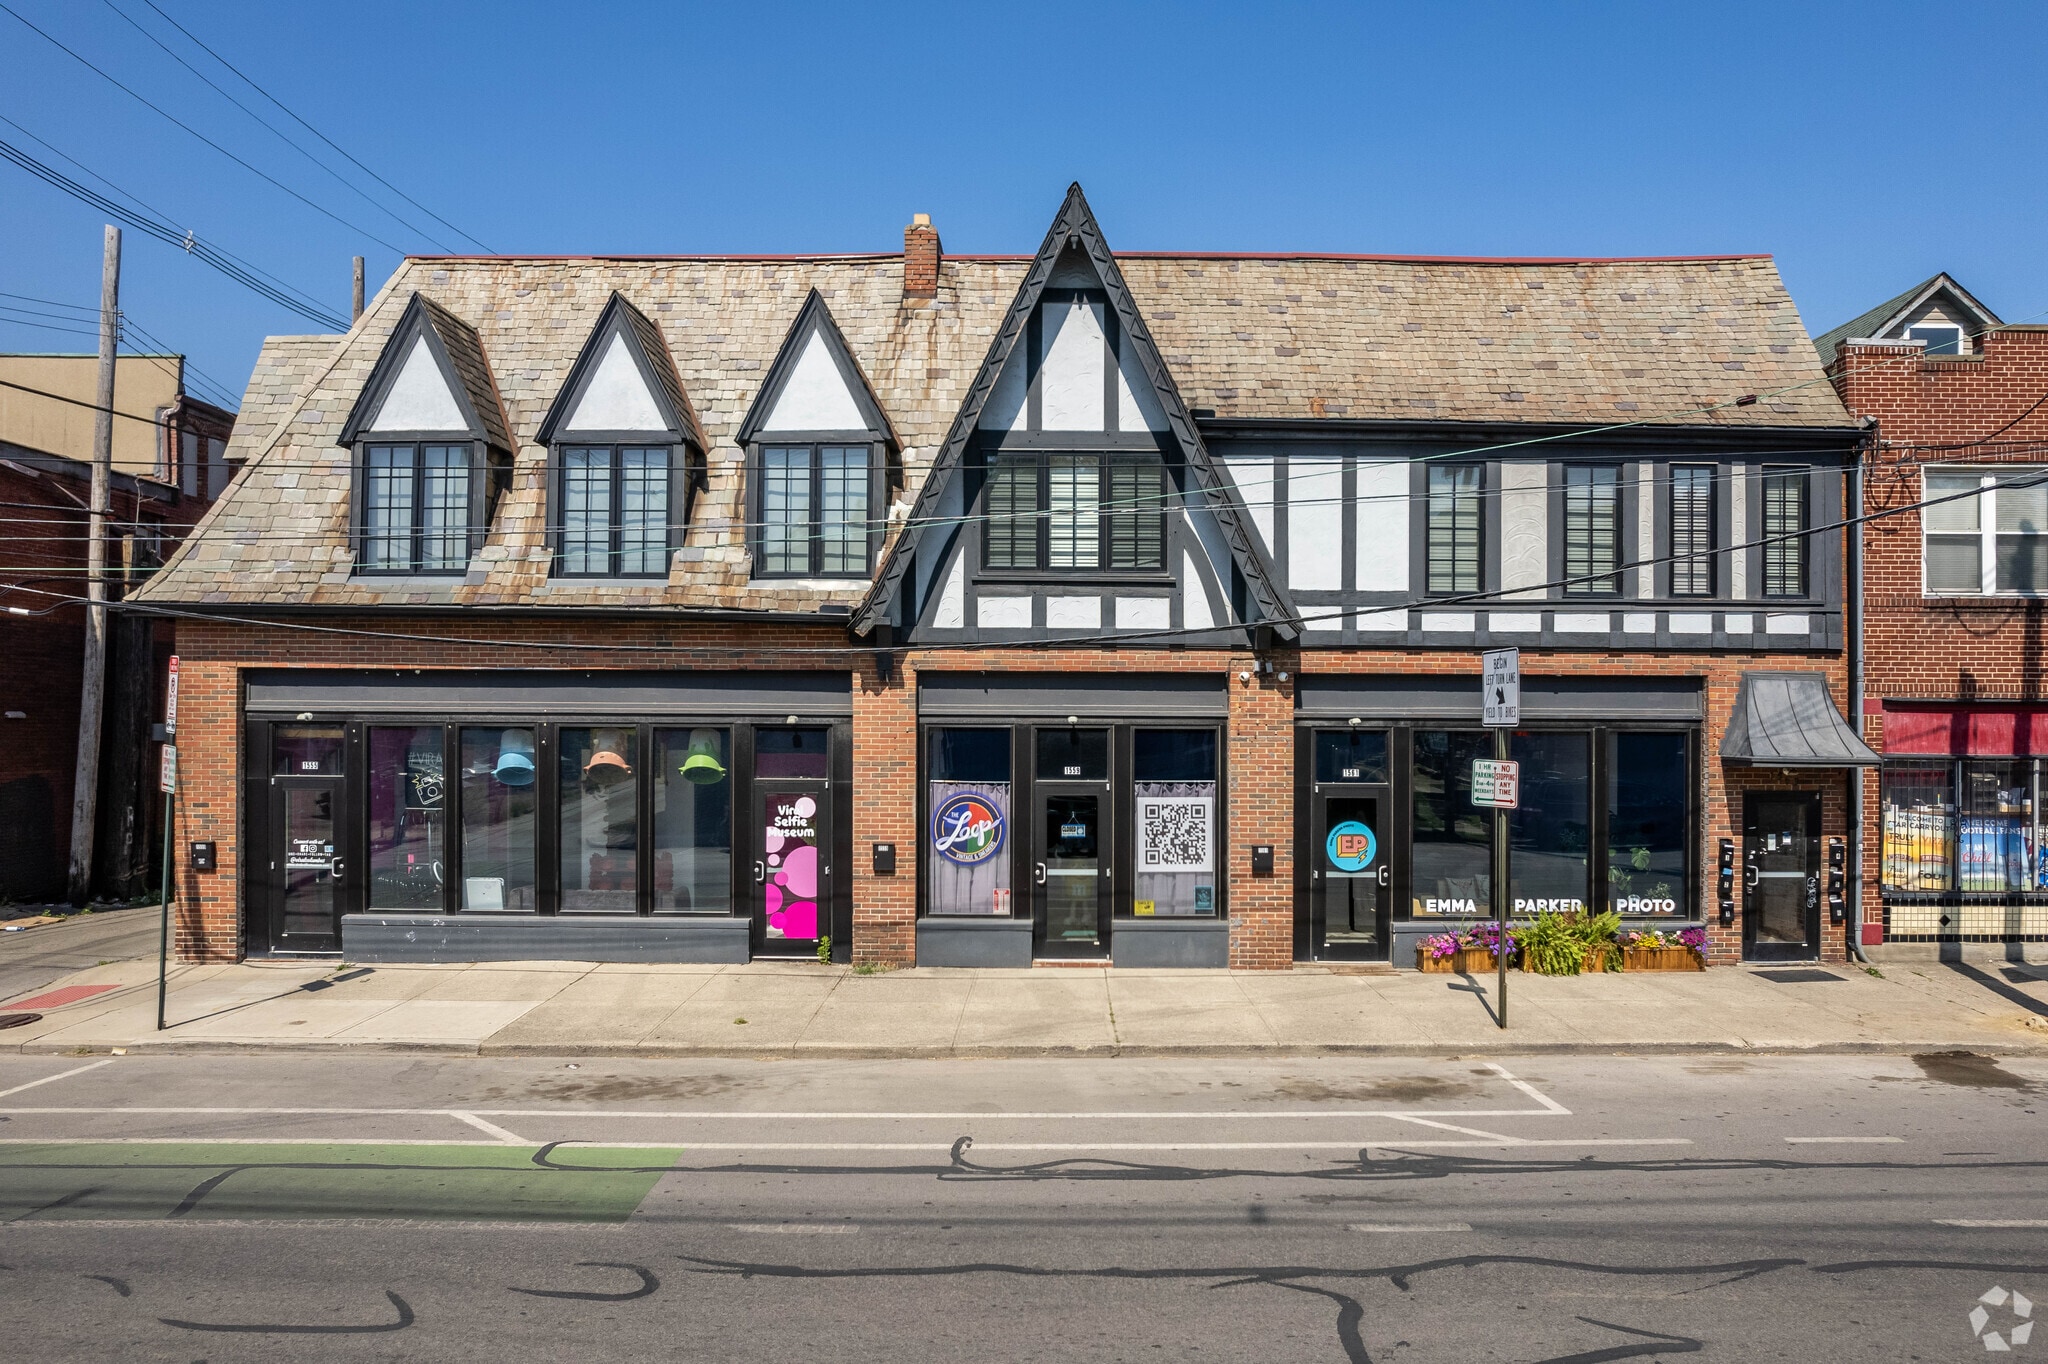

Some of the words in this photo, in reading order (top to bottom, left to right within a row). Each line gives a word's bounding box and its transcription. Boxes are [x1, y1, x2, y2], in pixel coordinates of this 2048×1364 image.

[1493, 657, 1508, 670] BEGIN
[1485, 674, 1494, 686] LEFT
[1495, 673, 1505, 685] TURN
[1506, 672, 1516, 684] LANE
[1485, 706, 1495, 718] YIELD
[1497, 706, 1503, 718] TO
[1505, 706, 1516, 718] BIKES
[1483, 763, 1492, 771] HR
[1501, 764, 1511, 773] NO
[1475, 771, 1494, 780] PARKING
[1496, 772, 1515, 782] STOPPING
[1499, 781, 1511, 789] ANY
[1498, 788, 1511, 796] TIME
[951, 811, 960, 819] THE
[1897, 814, 1932, 824] WELCOME
[1934, 817, 1944, 825] TO
[774, 815, 807, 827] Selfie
[768, 828, 814, 837] Museum
[935, 810, 1002, 851] Loop
[2000, 827, 2021, 835] FANS
[1888, 832, 1914, 842] TRULY
[1337, 834, 1369, 858] EP
[1426, 898, 1477, 913] EMMA
[1514, 898, 1582, 913] PARKER
[1616, 898, 1676, 913] PHOTO
